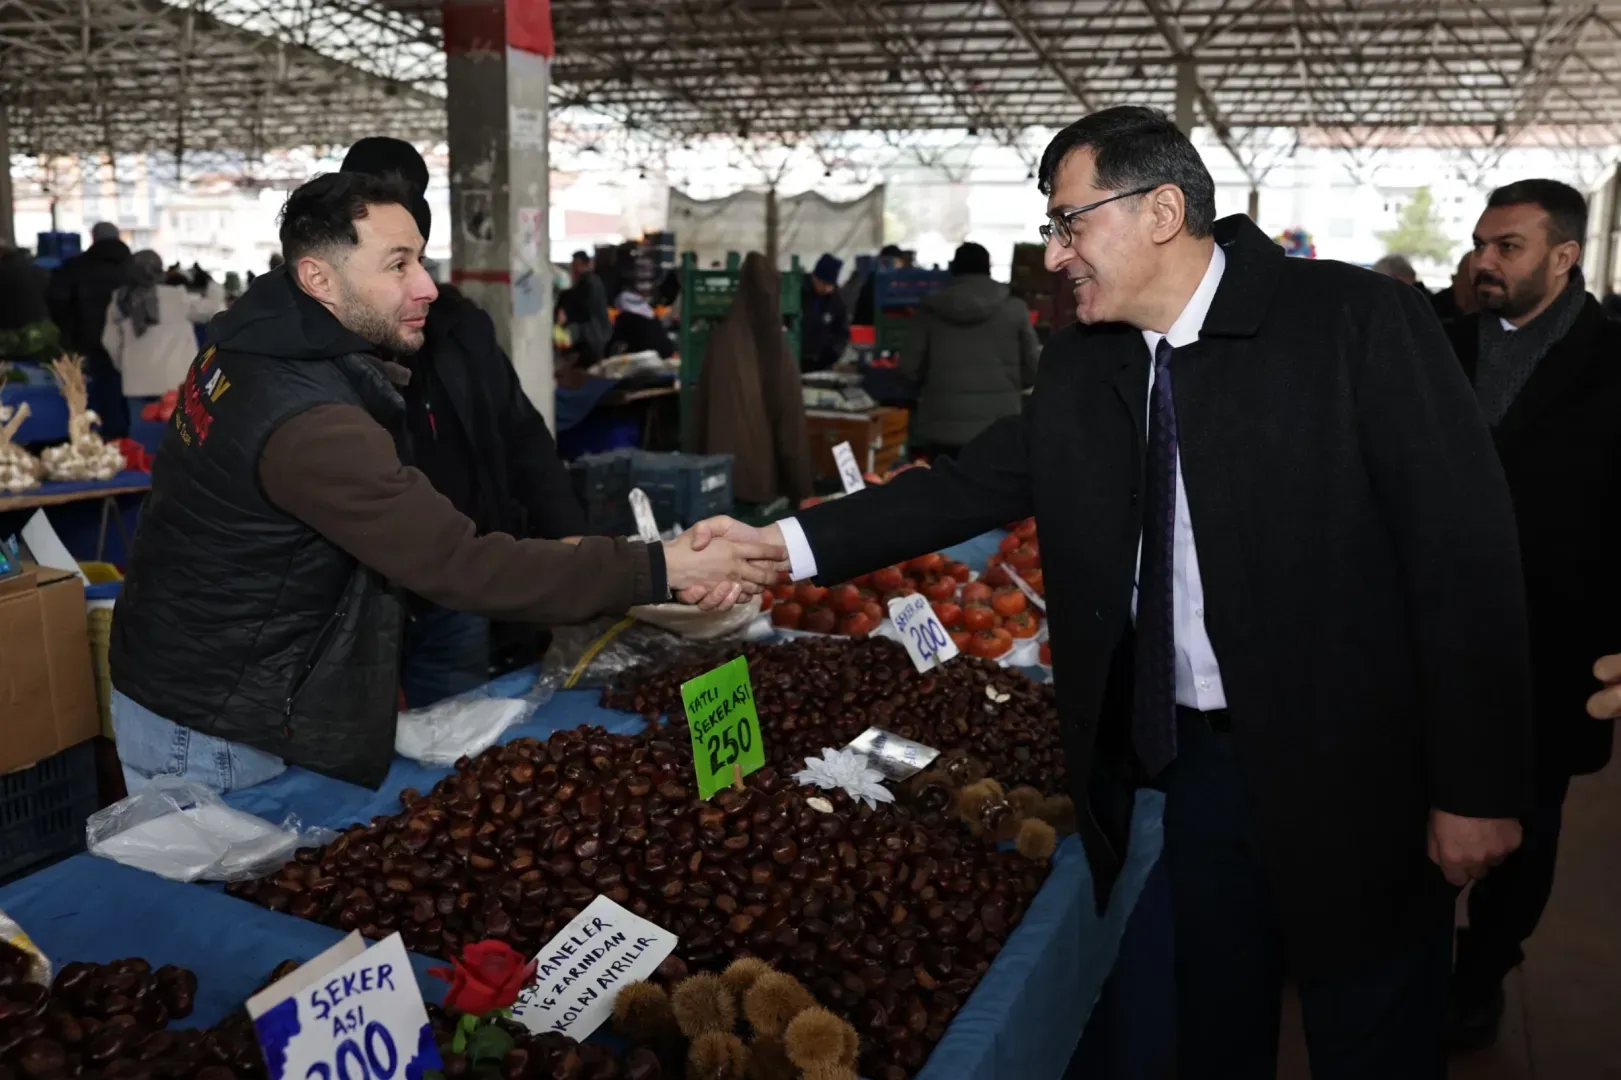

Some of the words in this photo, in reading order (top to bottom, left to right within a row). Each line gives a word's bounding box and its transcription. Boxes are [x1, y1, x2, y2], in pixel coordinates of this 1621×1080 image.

[910, 617, 947, 661] 200
[688, 686, 719, 714] TATLI
[707, 717, 752, 776] 250
[309, 963, 395, 1020] ŞEKER
[552, 931, 627, 996] ZARINDAN
[552, 987, 599, 1032] KOLAY
[596, 936, 658, 990] AYRILIR
[333, 1005, 364, 1039] AŞI
